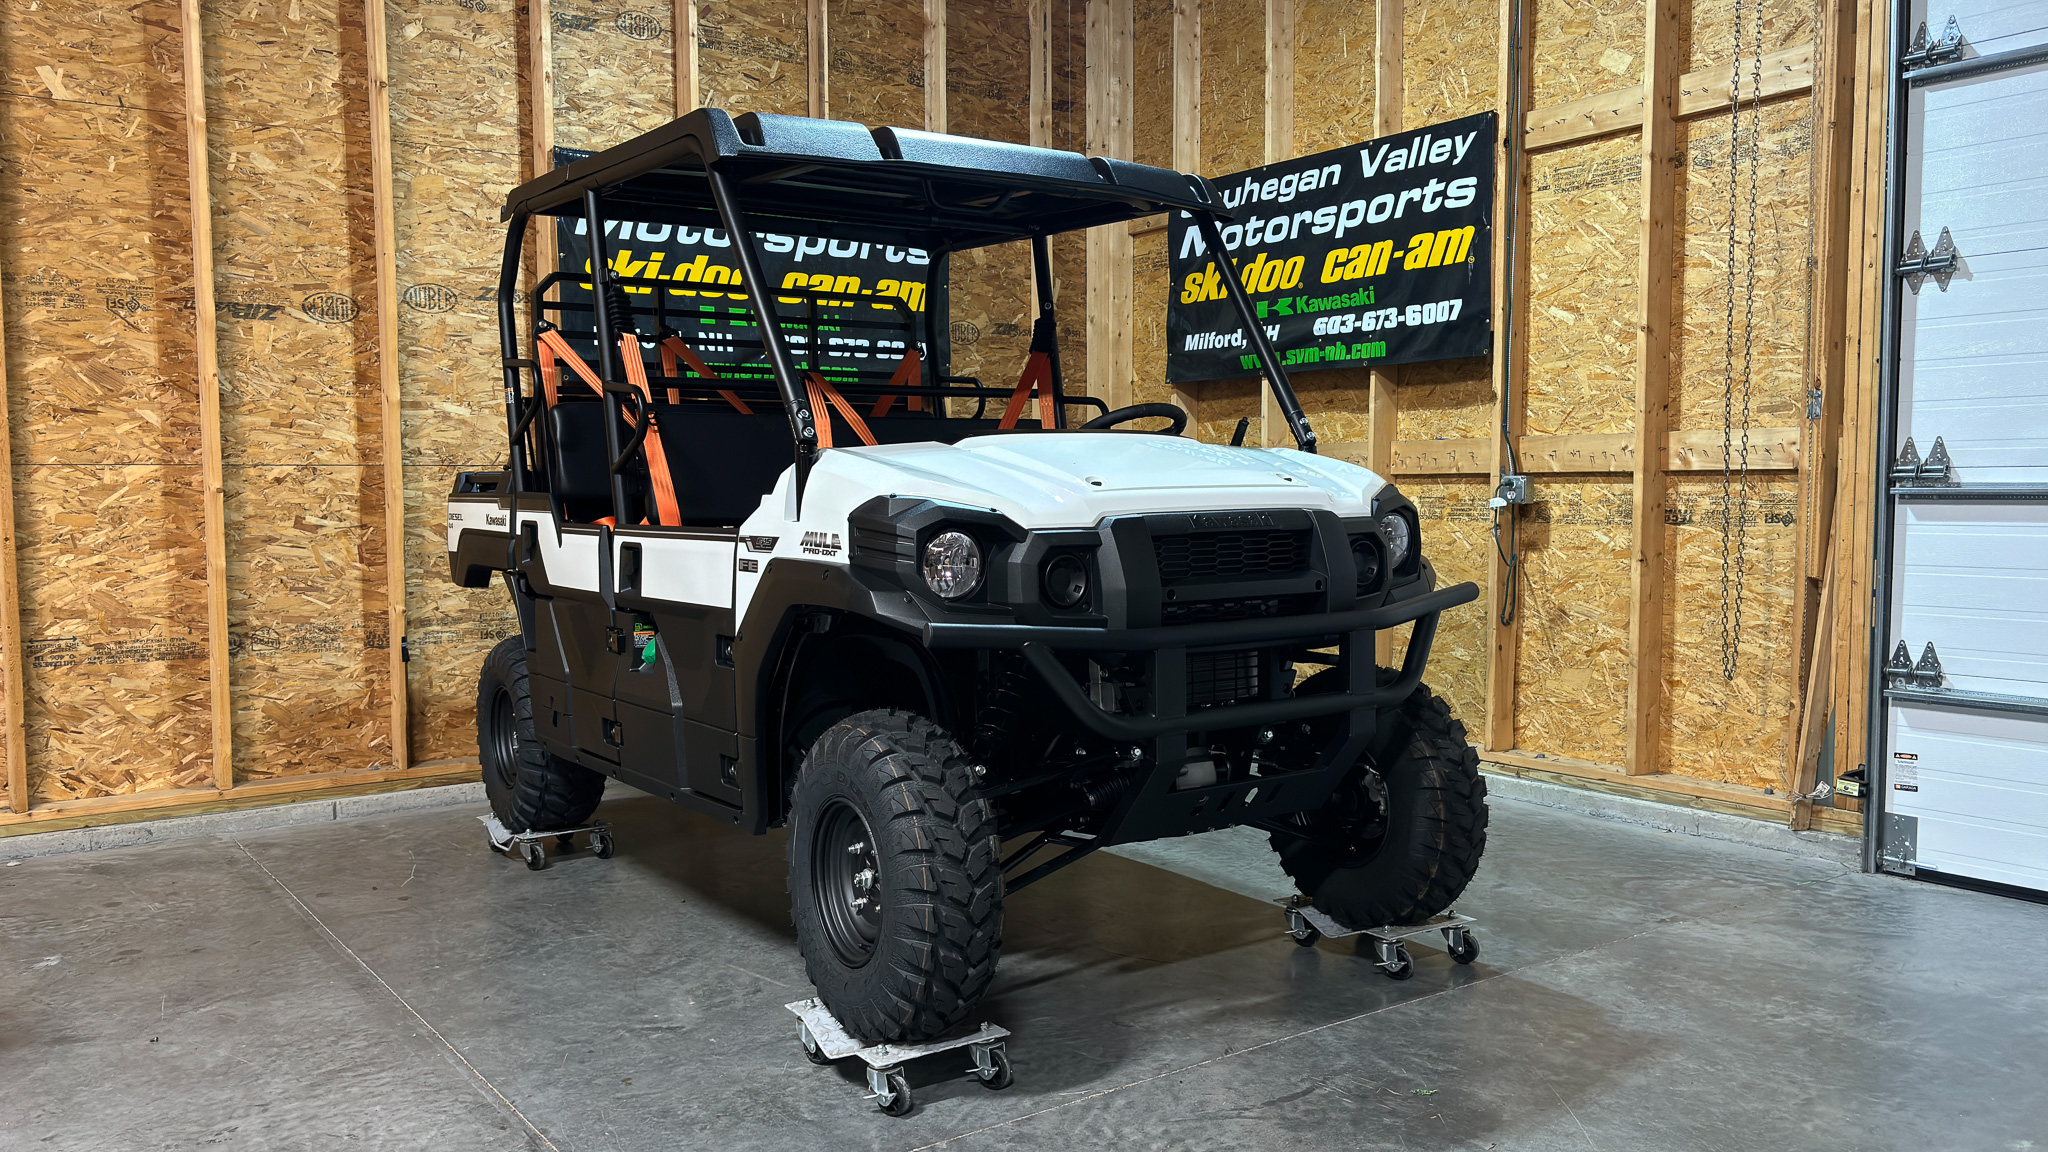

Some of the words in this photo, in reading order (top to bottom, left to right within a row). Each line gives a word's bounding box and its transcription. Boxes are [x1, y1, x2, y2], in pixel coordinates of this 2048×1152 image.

[1181, 163, 1342, 218] uhegan
[1360, 131, 1478, 178] Valley
[1179, 176, 1479, 259] Motorsports
[574, 218, 931, 265] otosports
[1181, 252, 1305, 304] skdoo
[1320, 226, 1476, 284] can-am
[1296, 286, 1375, 313] Kawasaki
[1184, 329, 1247, 351] Milford,
[1263, 324, 1280, 341] H
[1313, 299, 1463, 336] 603-673-6007
[1240, 340, 1387, 370] w.svm-nh.com
[486, 513, 507, 527] Kawasaki
[800, 531, 842, 550] MULE
[803, 547, 838, 557] PRO-DXT
[739, 560, 758, 572] FE
[480, 630, 495, 640] SFI
